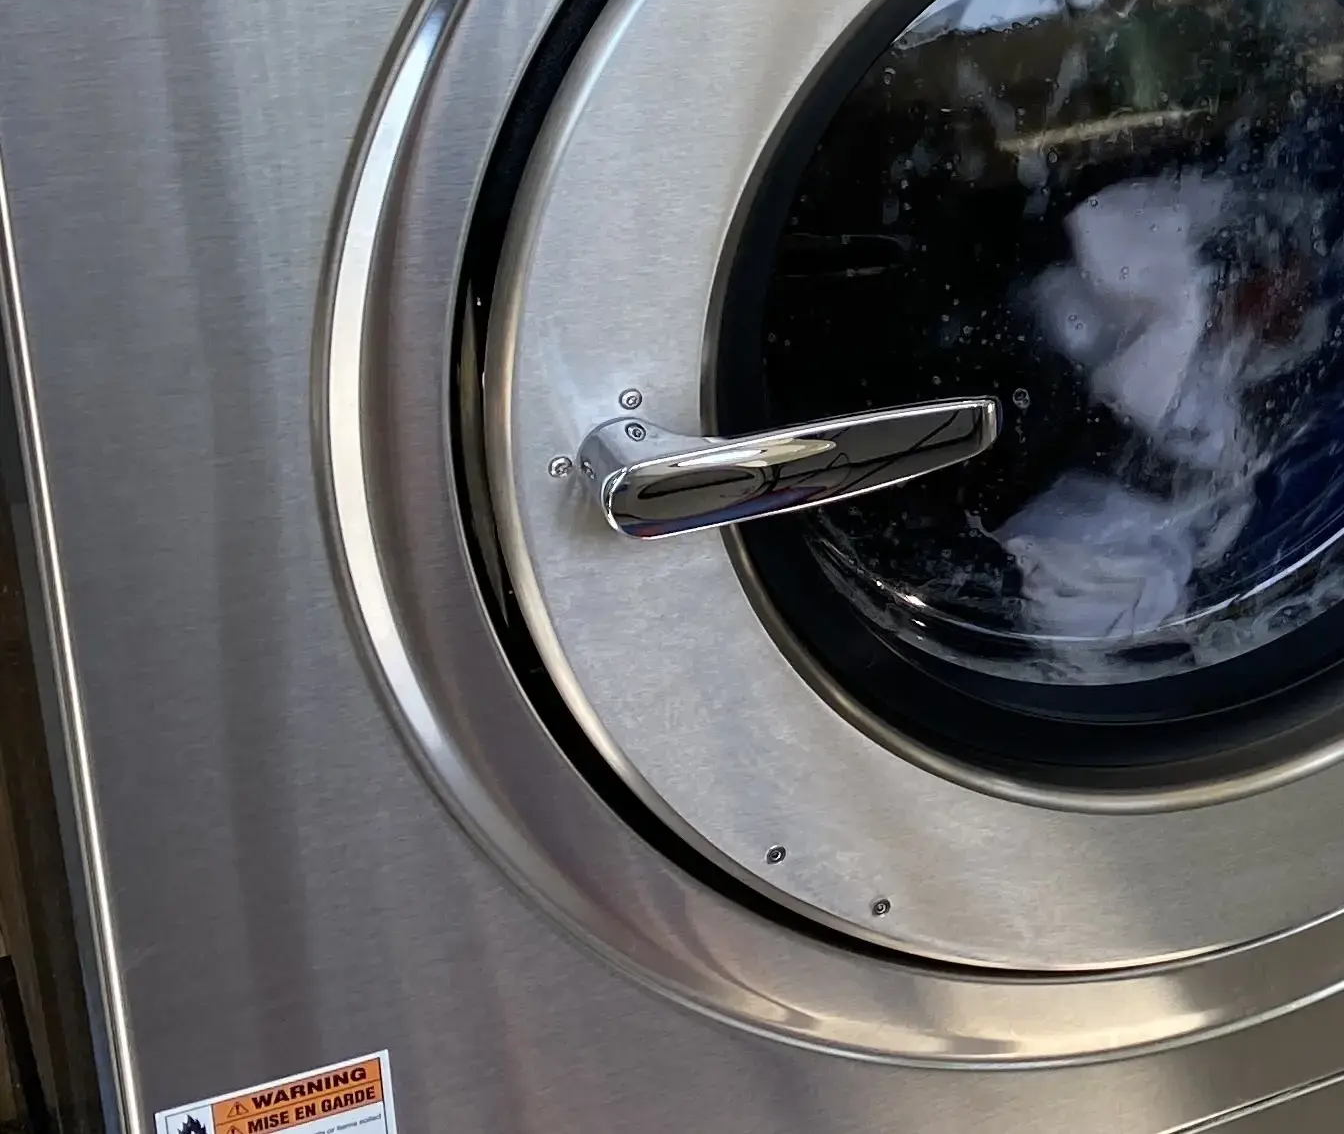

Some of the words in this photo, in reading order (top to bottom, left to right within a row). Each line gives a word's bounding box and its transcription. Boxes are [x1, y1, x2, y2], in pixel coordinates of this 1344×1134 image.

[247, 1110, 290, 1134] MISE
[295, 1102, 315, 1121] EN
[321, 1086, 376, 1113] GARDE
[252, 1067, 367, 1109] WARNING
